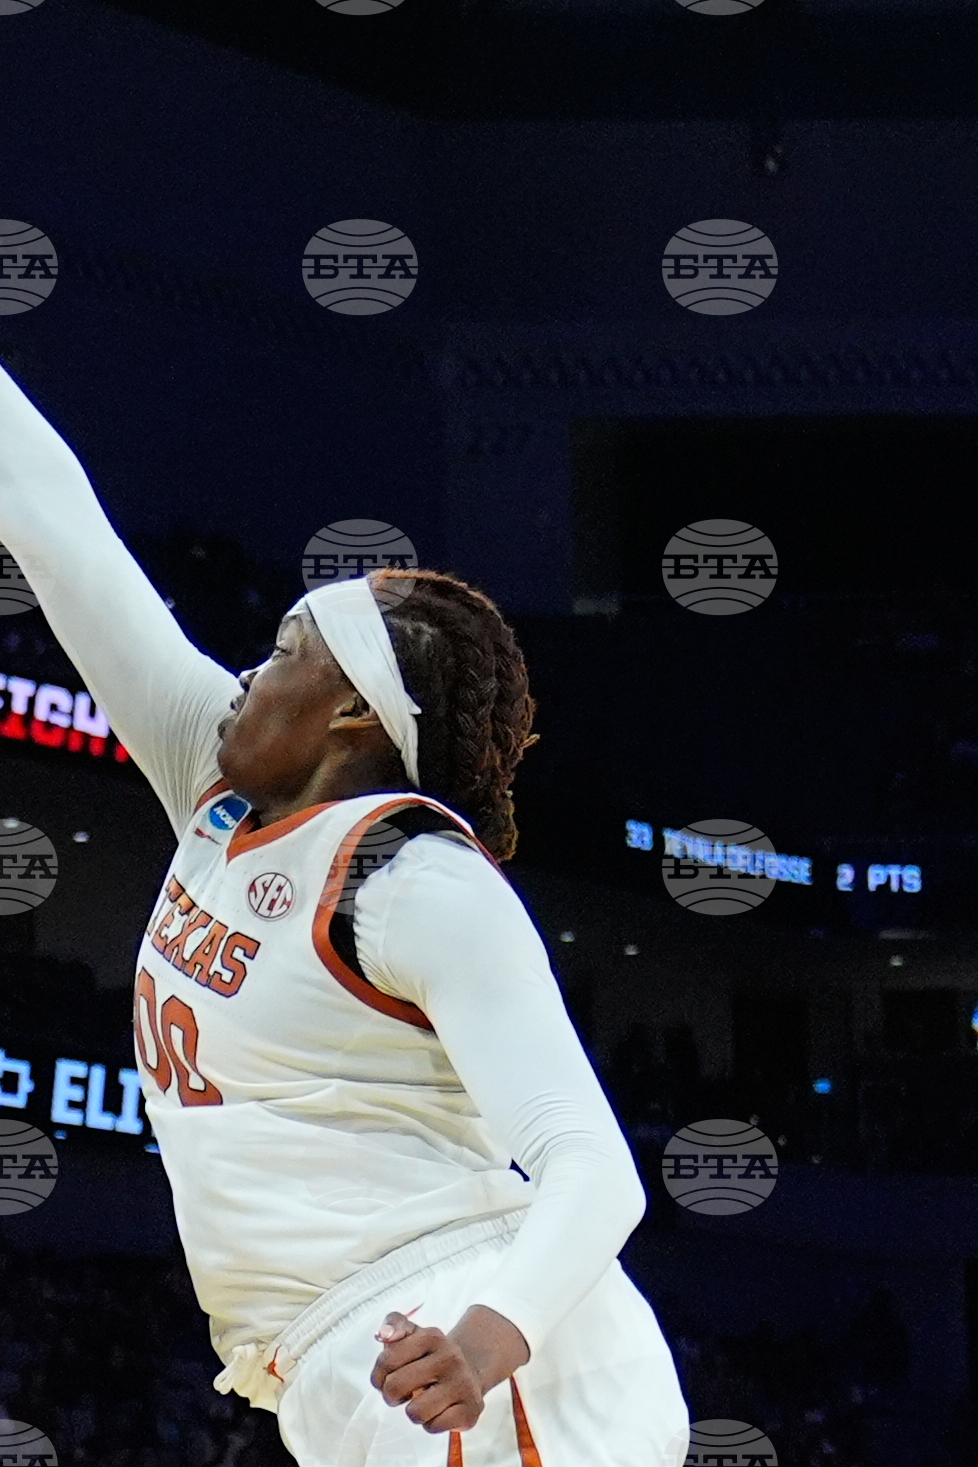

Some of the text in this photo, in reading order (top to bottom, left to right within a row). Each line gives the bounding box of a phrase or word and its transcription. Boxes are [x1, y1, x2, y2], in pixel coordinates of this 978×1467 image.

[213, 805, 238, 828] NCAA
[249, 873, 293, 918] SEC
[836, 863, 922, 893] 2 PTS
[146, 874, 261, 998] TEXAS
[134, 966, 224, 1107] 00
[51, 1057, 156, 1138] ELI
